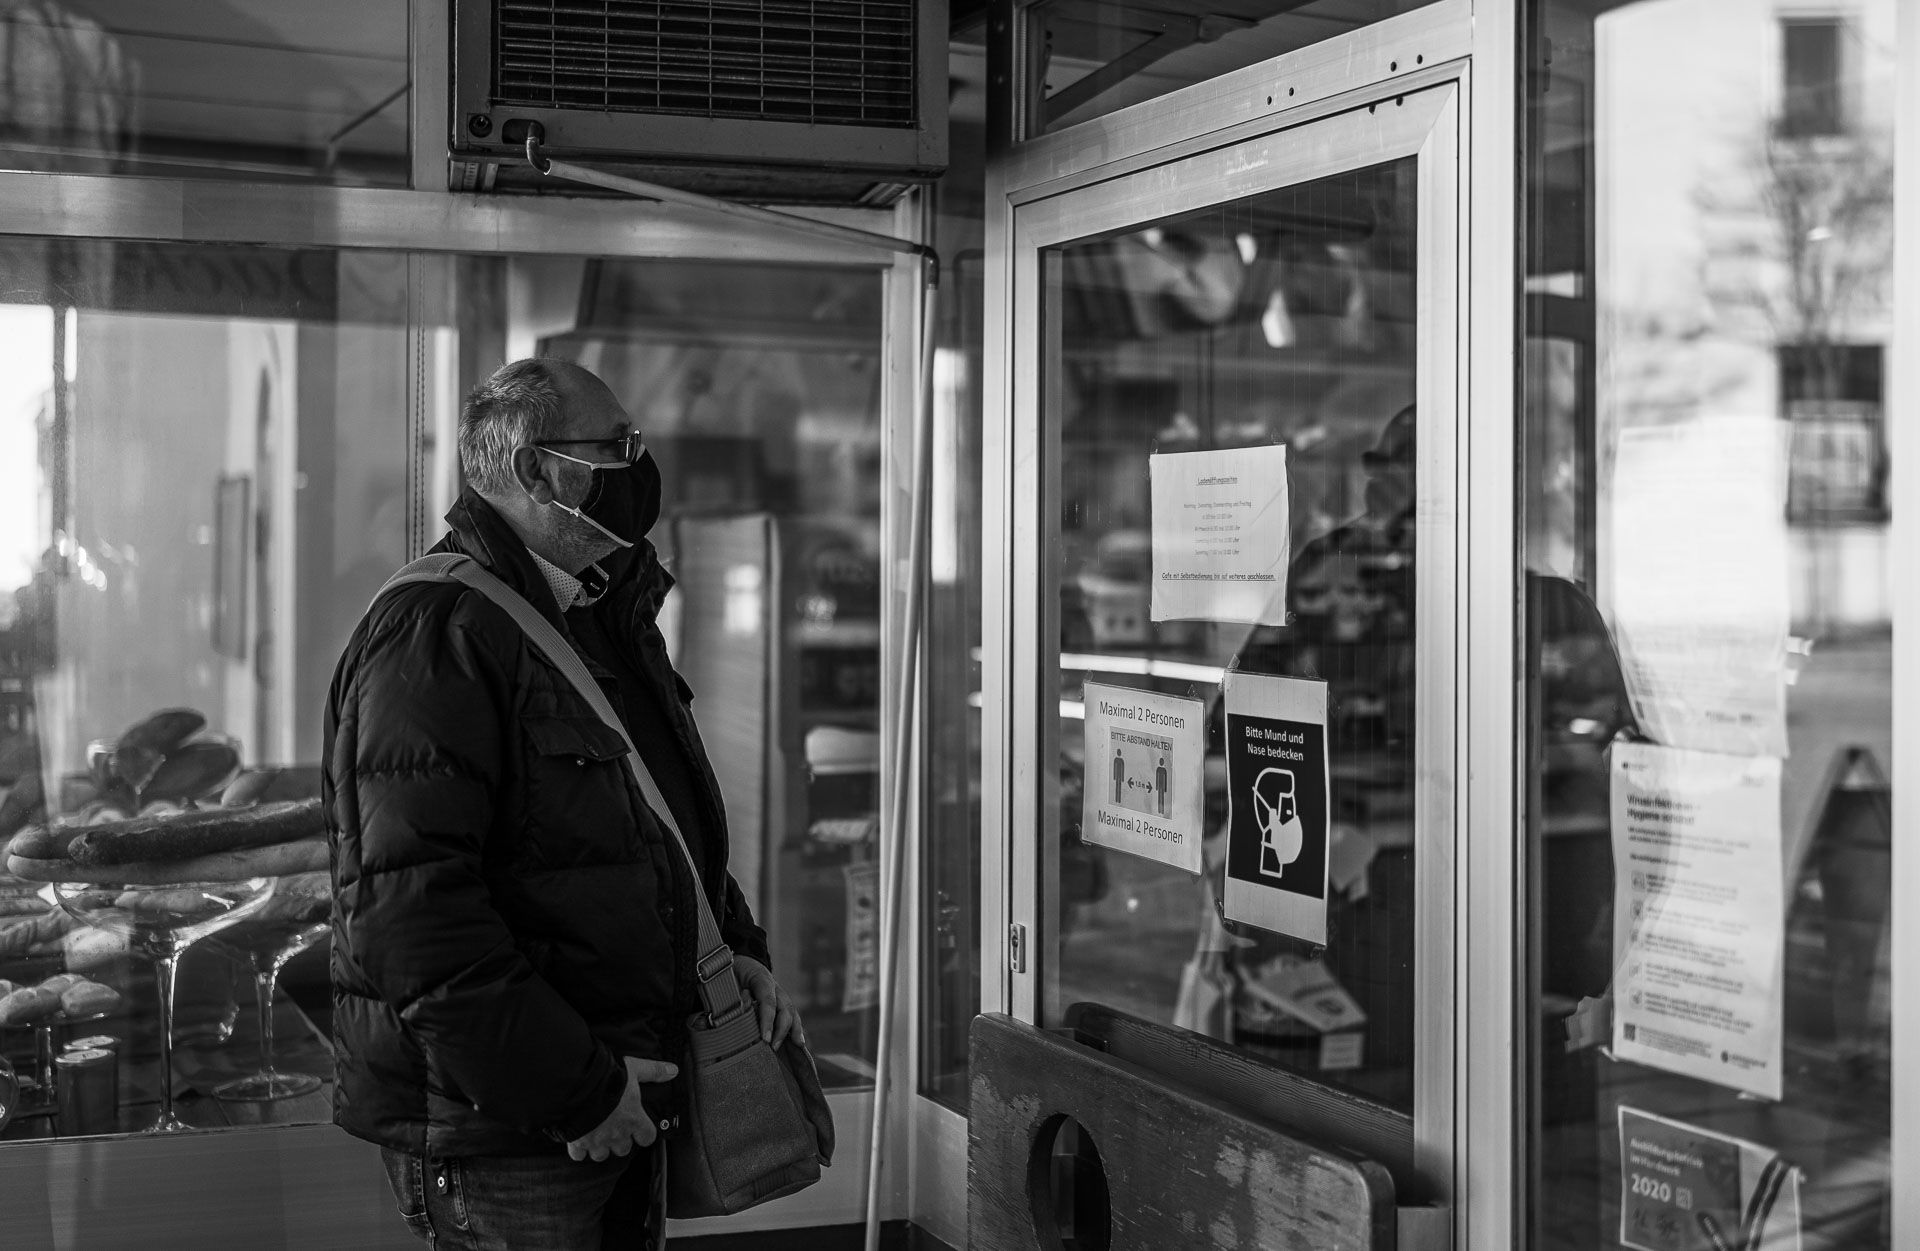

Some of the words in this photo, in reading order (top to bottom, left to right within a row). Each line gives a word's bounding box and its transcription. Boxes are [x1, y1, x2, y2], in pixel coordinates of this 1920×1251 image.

[1099, 701, 1136, 720] Maximal
[1138, 707, 1143, 721] 2
[1145, 708, 1185, 729] Personen
[1111, 732, 1126, 742] BITTE
[1127, 735, 1151, 747] ABSTAND
[1151, 741, 1172, 752] HALTEN
[1245, 726, 1263, 739] Bitte
[1264, 728, 1287, 742] Mund
[1289, 732, 1304, 744] und
[1247, 743, 1266, 756] Nase
[1267, 745, 1304, 761] bedecken
[1098, 810, 1134, 831] Maximal
[1136, 819, 1141, 833] 2
[1143, 821, 1183, 845] Personen
[1631, 1173, 1672, 1203] 2020
